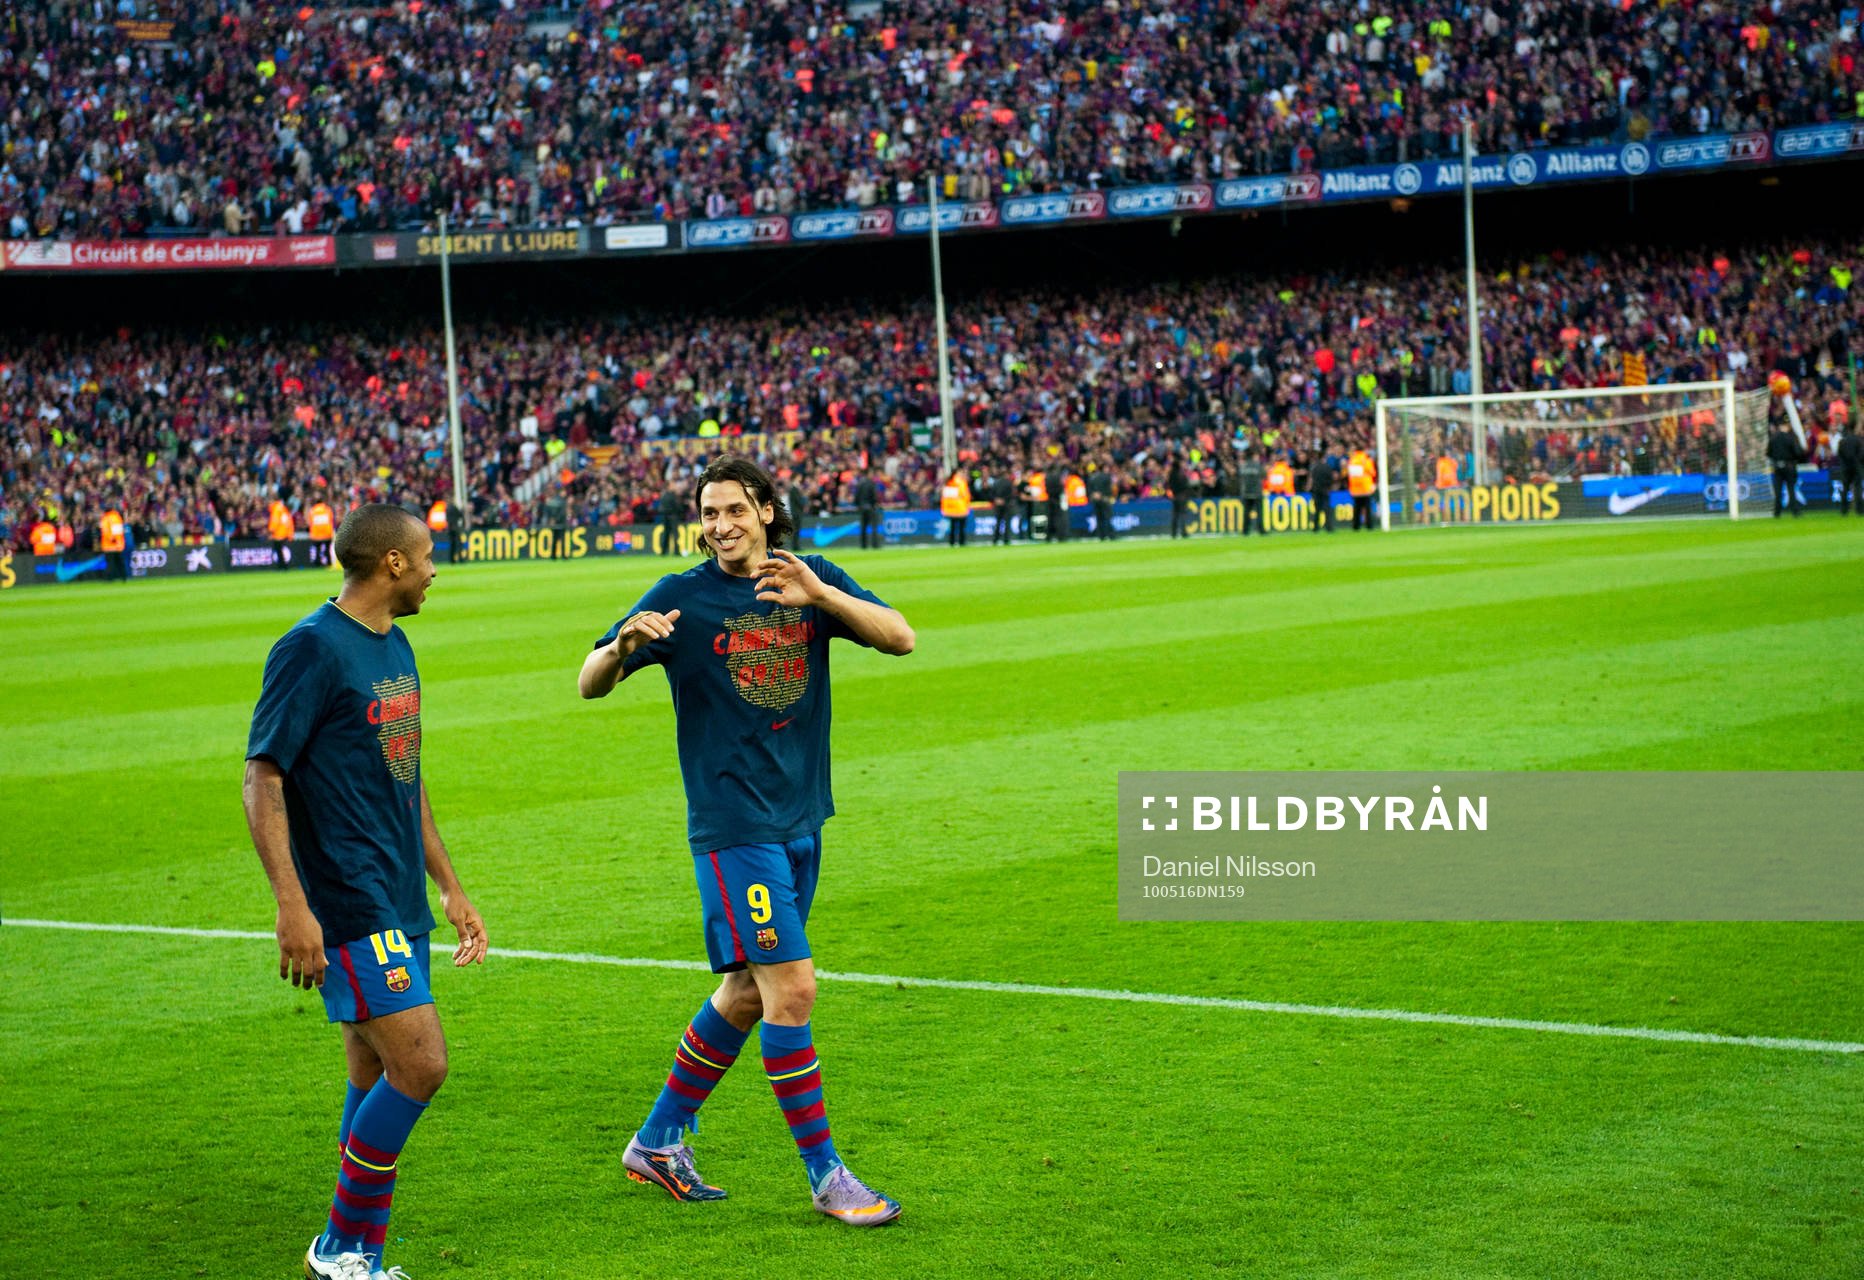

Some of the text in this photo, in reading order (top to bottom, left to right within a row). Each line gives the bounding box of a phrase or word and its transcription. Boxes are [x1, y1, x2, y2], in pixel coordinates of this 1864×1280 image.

[1546, 152, 1618, 175] Allianz
[1322, 171, 1390, 194] Allianz
[74, 243, 137, 263] Circuit
[142, 244, 167, 263] de
[171, 242, 268, 263] Catalunya
[738, 657, 805, 688] 09/10
[747, 883, 772, 925] 9
[369, 929, 412, 966] 14
